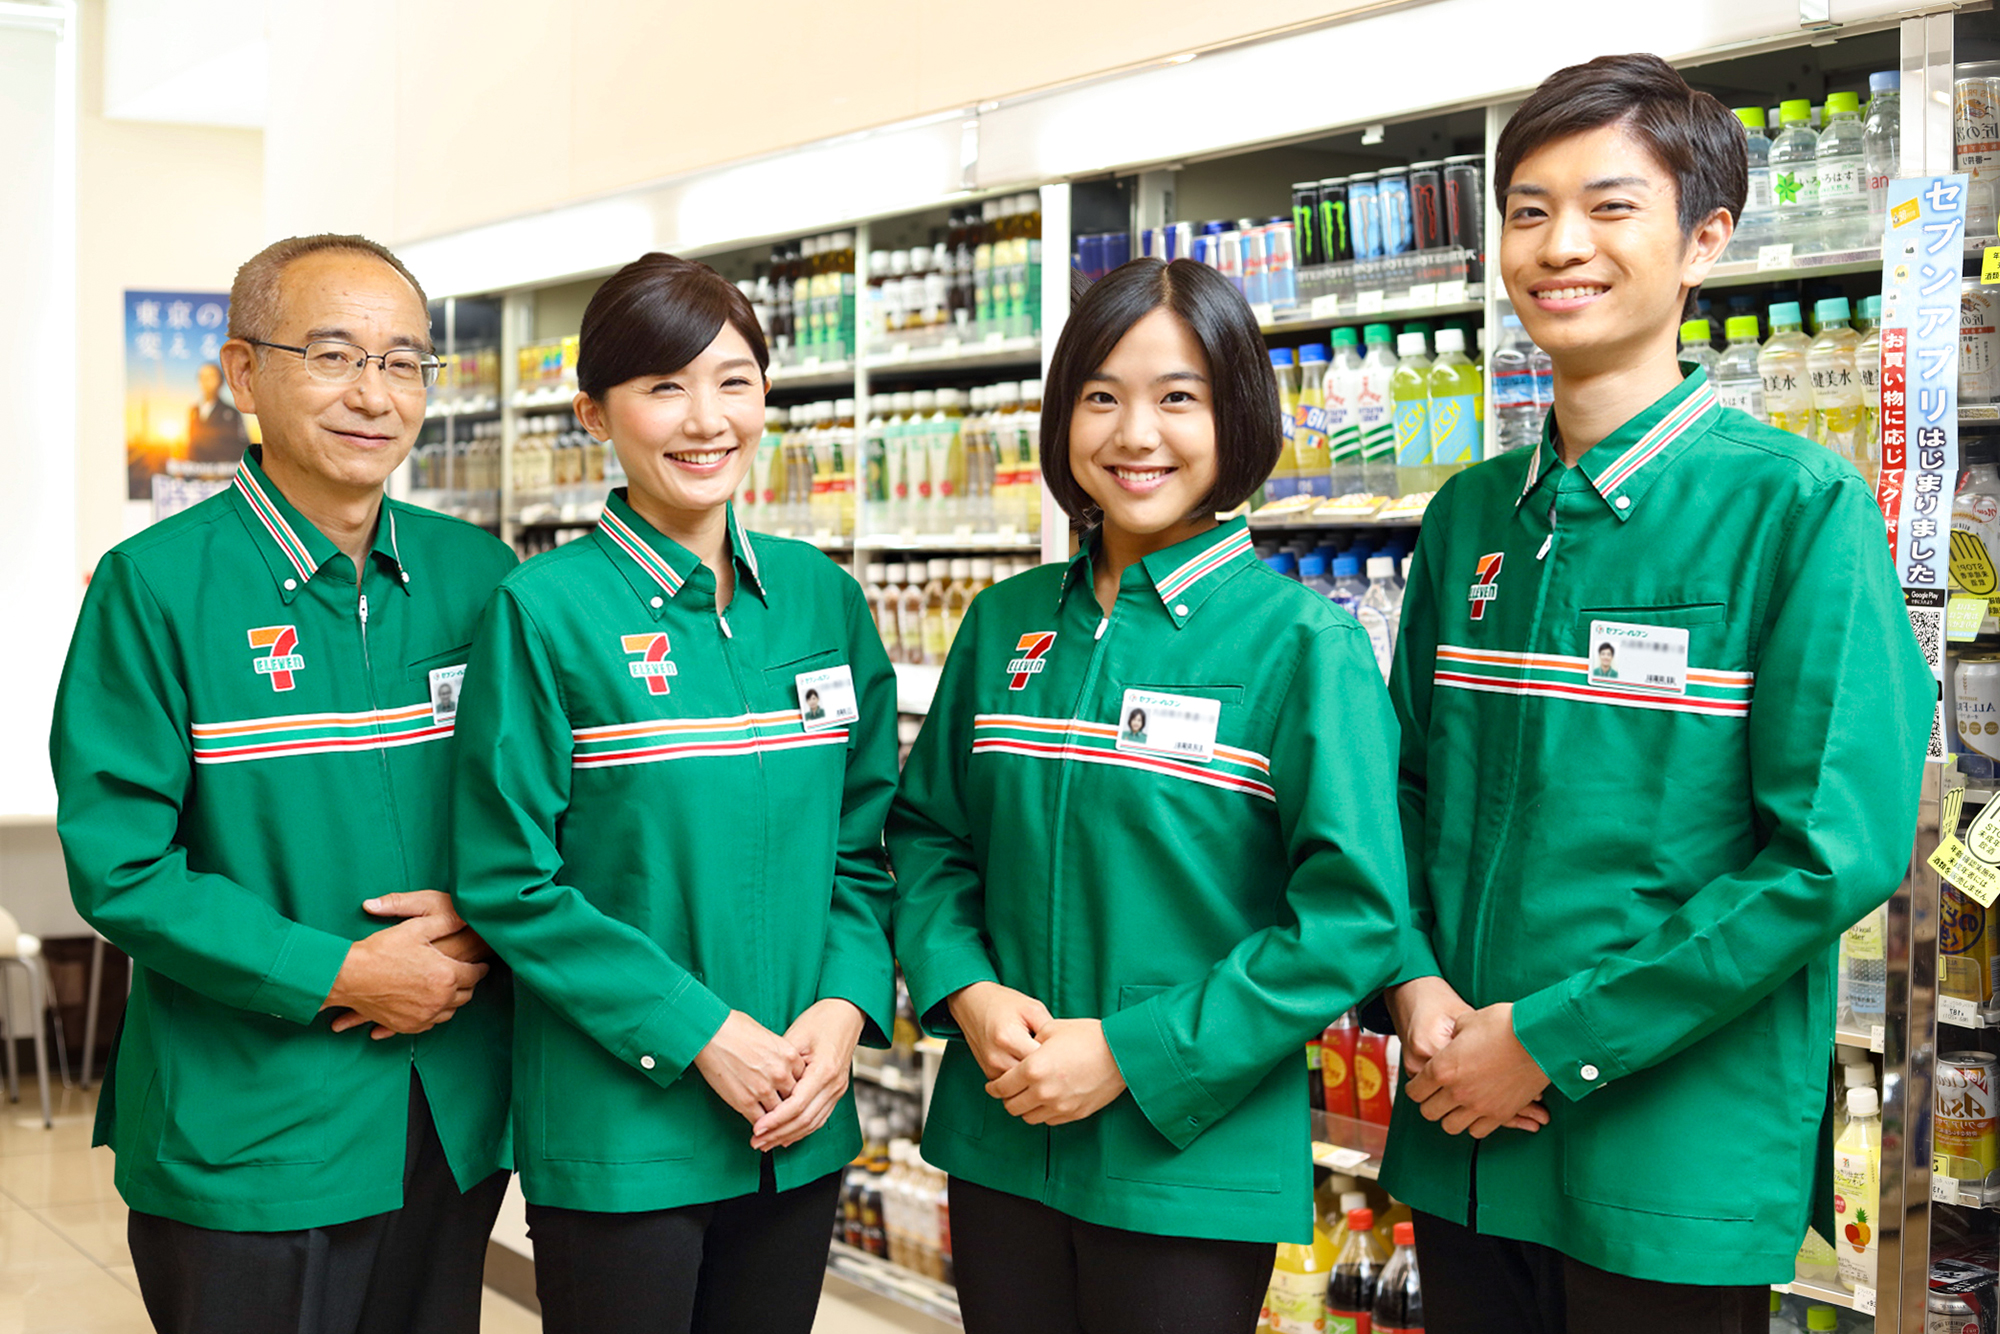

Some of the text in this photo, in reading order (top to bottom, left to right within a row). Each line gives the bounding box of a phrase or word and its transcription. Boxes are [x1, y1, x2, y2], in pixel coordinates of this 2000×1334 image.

[134, 299, 229, 330] 東京の
[1906, 180, 1962, 585] セブンアプリはじまりました
[1911, 590, 1940, 601] Google Play
[1978, 841, 1996, 856] 飲酒
[1948, 857, 1988, 888] 未成年者には
